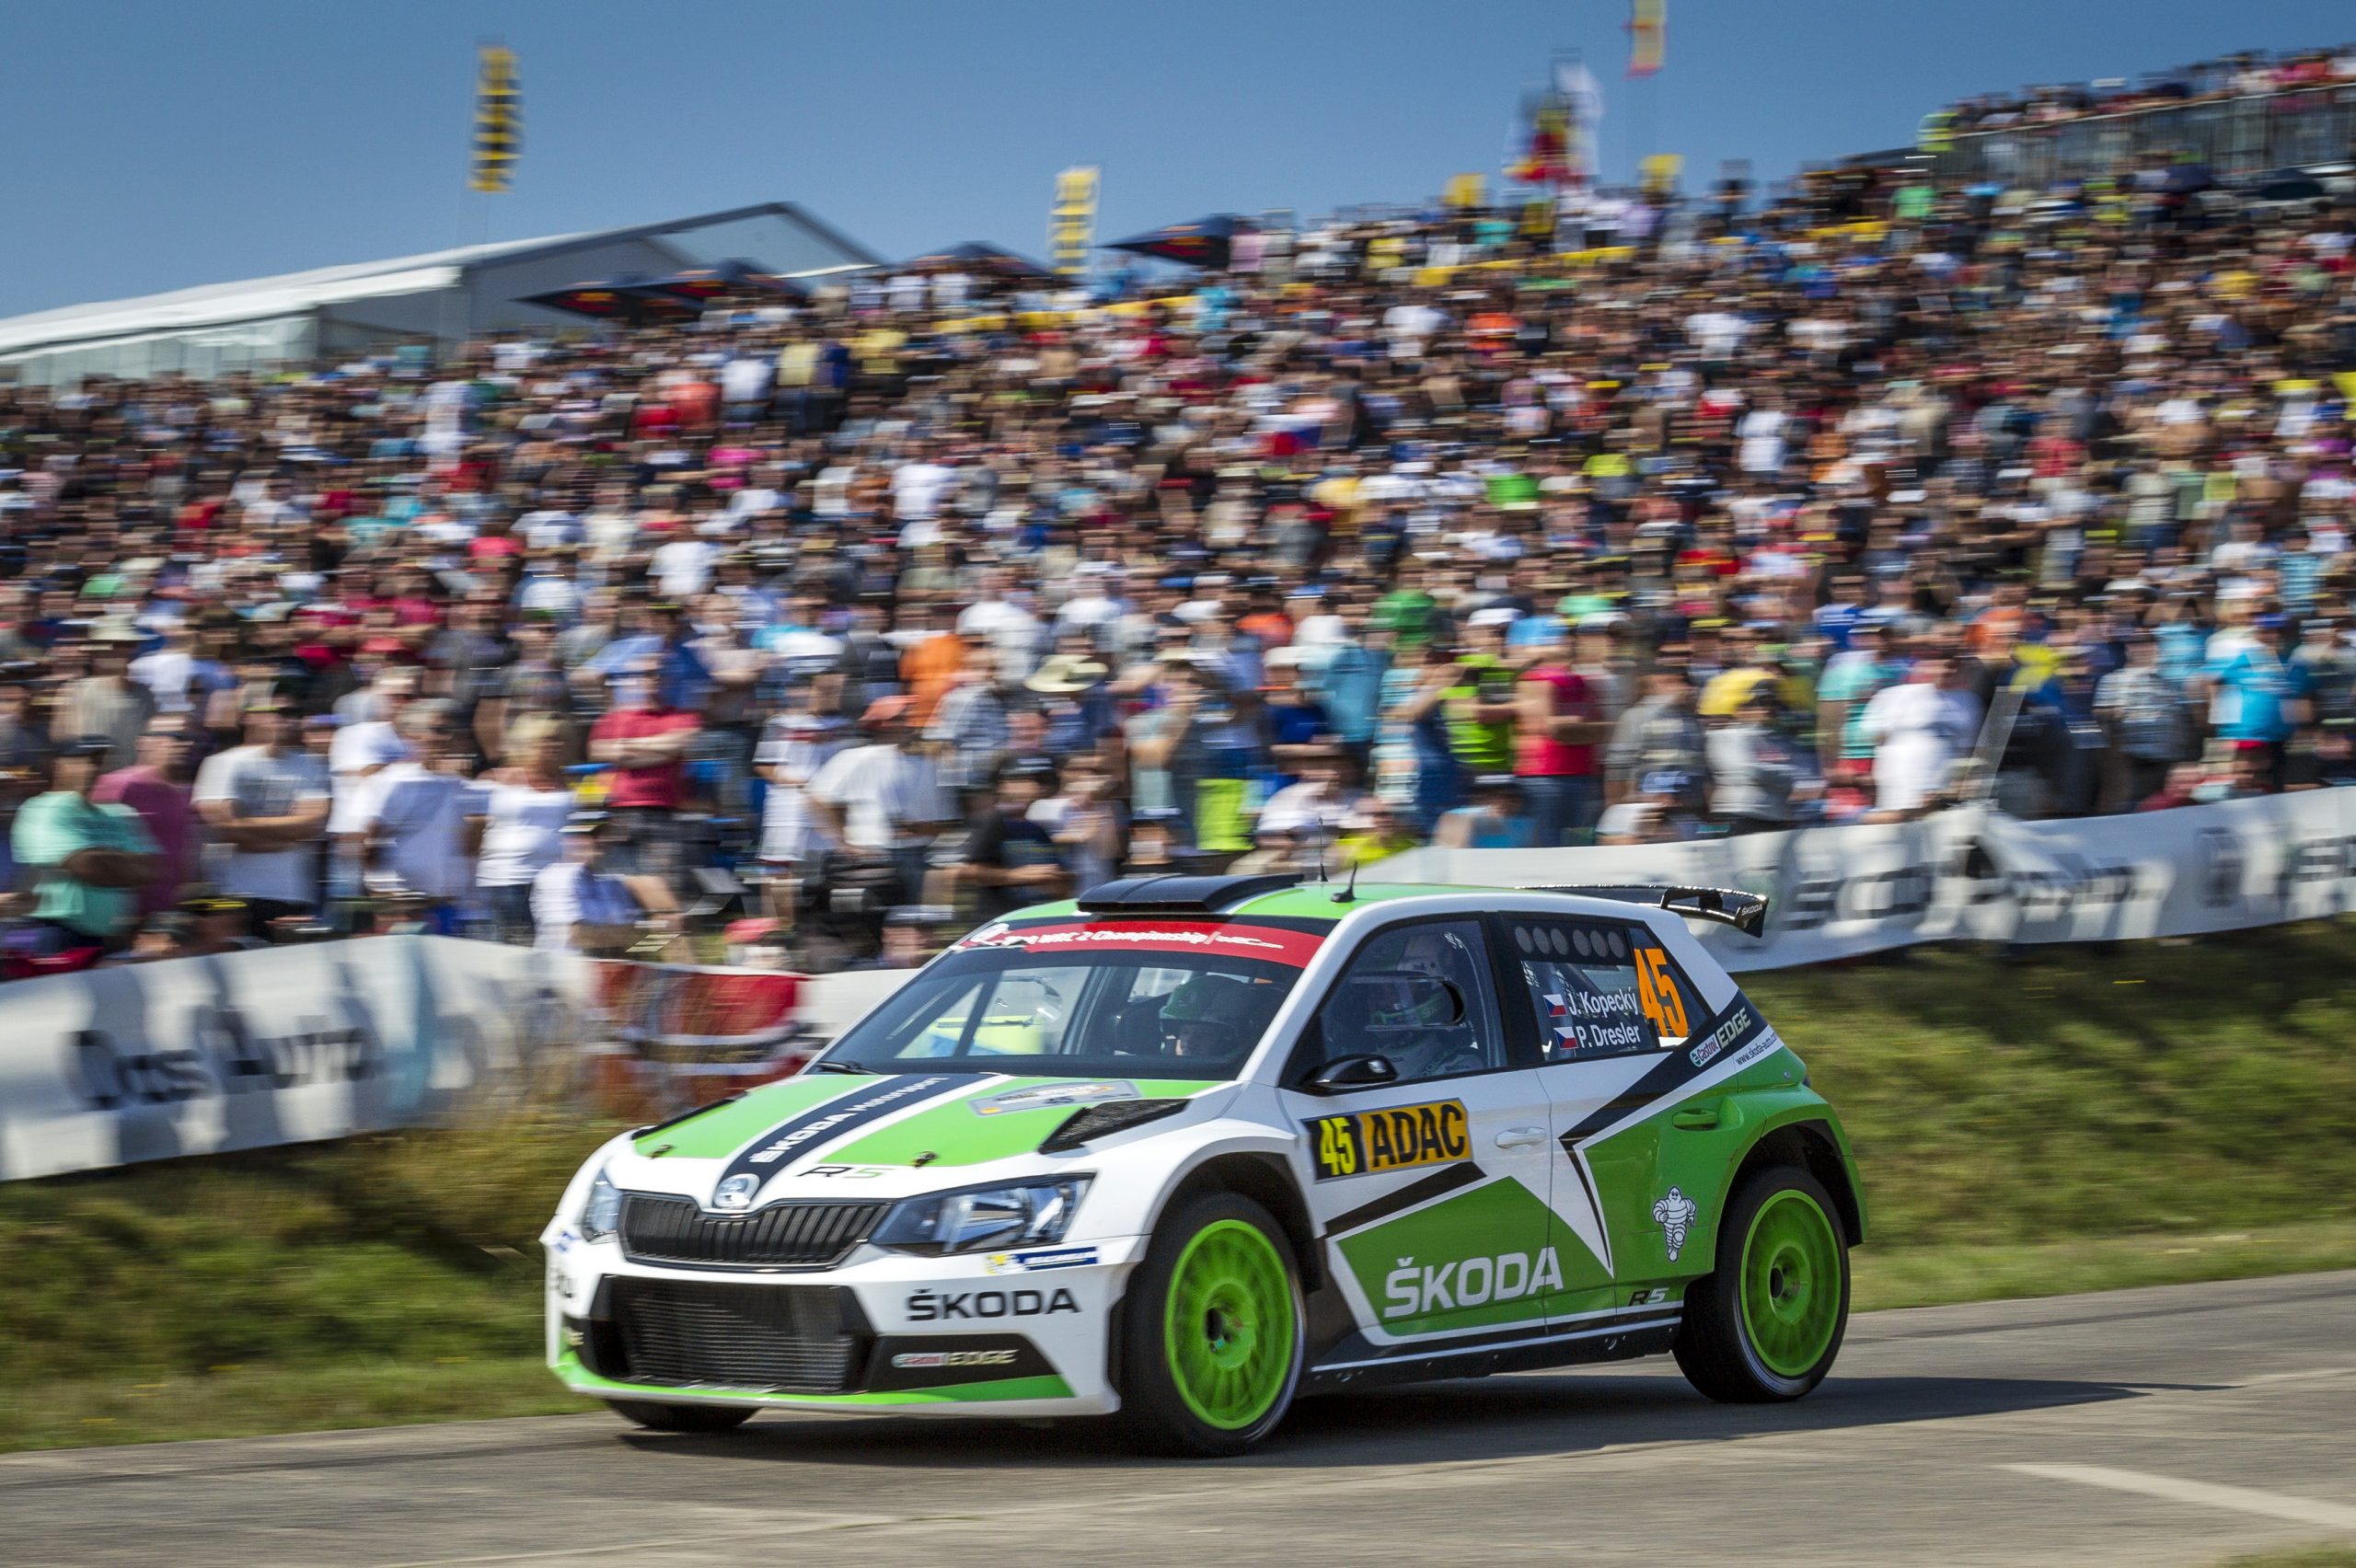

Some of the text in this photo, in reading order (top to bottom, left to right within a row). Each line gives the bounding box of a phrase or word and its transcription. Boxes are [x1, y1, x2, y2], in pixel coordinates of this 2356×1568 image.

[1075, 930, 1093, 942] 2
[1091, 929, 1209, 945] Championship
[1567, 986, 1639, 1019] J. Kopecký
[1634, 948, 1690, 1038] 45
[1576, 1020, 1642, 1049] P. Dresler
[1696, 1007, 1752, 1063] Castrol EDGE
[1319, 1103, 1466, 1176] 45 ADAC
[794, 1166, 896, 1179] R5
[1383, 1247, 1565, 1319] ŠKODA
[1627, 1287, 1671, 1308] R5
[906, 1287, 1083, 1322] ŠKODA
[945, 1349, 1020, 1366] EDGE
